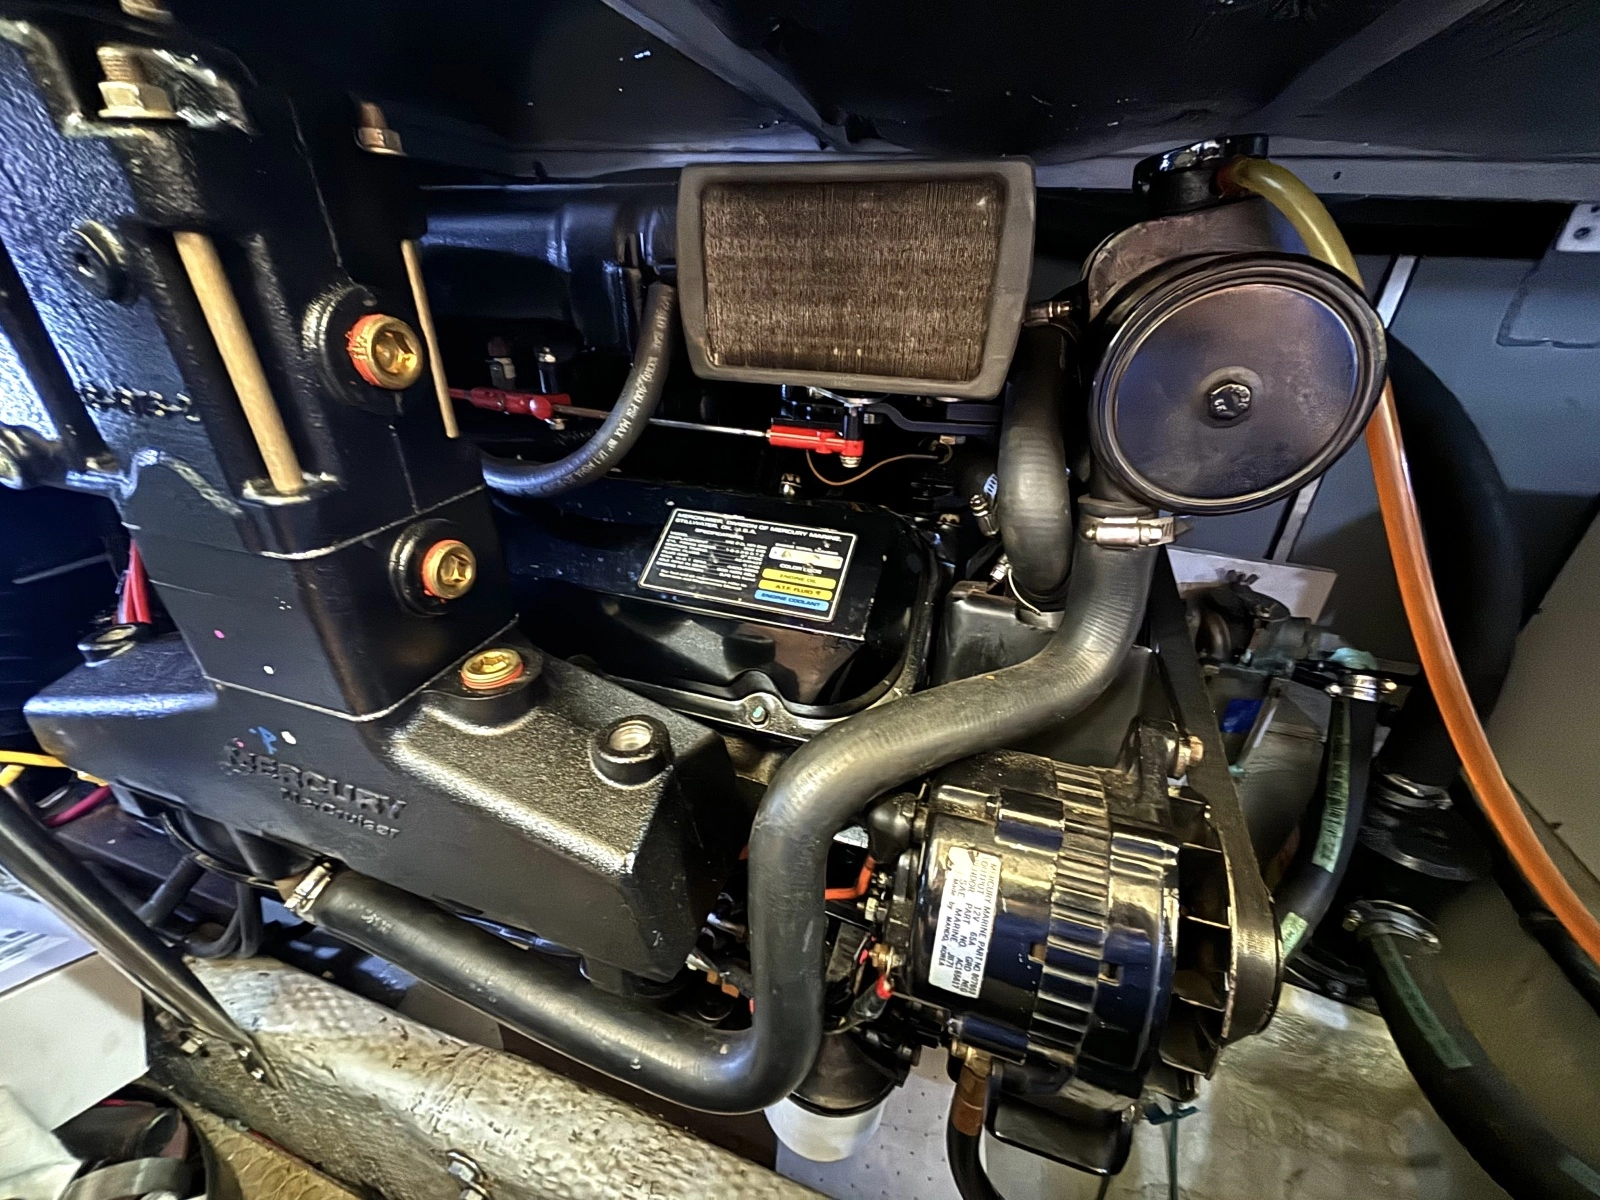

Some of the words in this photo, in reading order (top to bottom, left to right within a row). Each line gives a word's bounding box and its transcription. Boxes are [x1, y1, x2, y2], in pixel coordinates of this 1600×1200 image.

[614, 420, 633, 439] MAX
[770, 527, 808, 538] MERCURY
[793, 587, 814, 595] FLUID
[761, 593, 787, 602] ENGINE
[789, 597, 821, 608] COOLANT
[222, 744, 407, 819] MERCURY
[977, 860, 988, 894] OUTPUT
[984, 864, 997, 904] MERCURY
[951, 879, 959, 896] Made
[957, 880, 967, 898] SAE
[947, 901, 955, 910] by
[962, 903, 973, 924] PART
[972, 906, 981, 922] 12V
[950, 908, 962, 943] MARINE
[979, 906, 991, 938] MARINE
[968, 932, 977, 947] 65A
[938, 945, 948, 966] KOREA
[975, 941, 986, 961] PART
[964, 956, 974, 972] GRD
[960, 979, 970, 993] NEG
